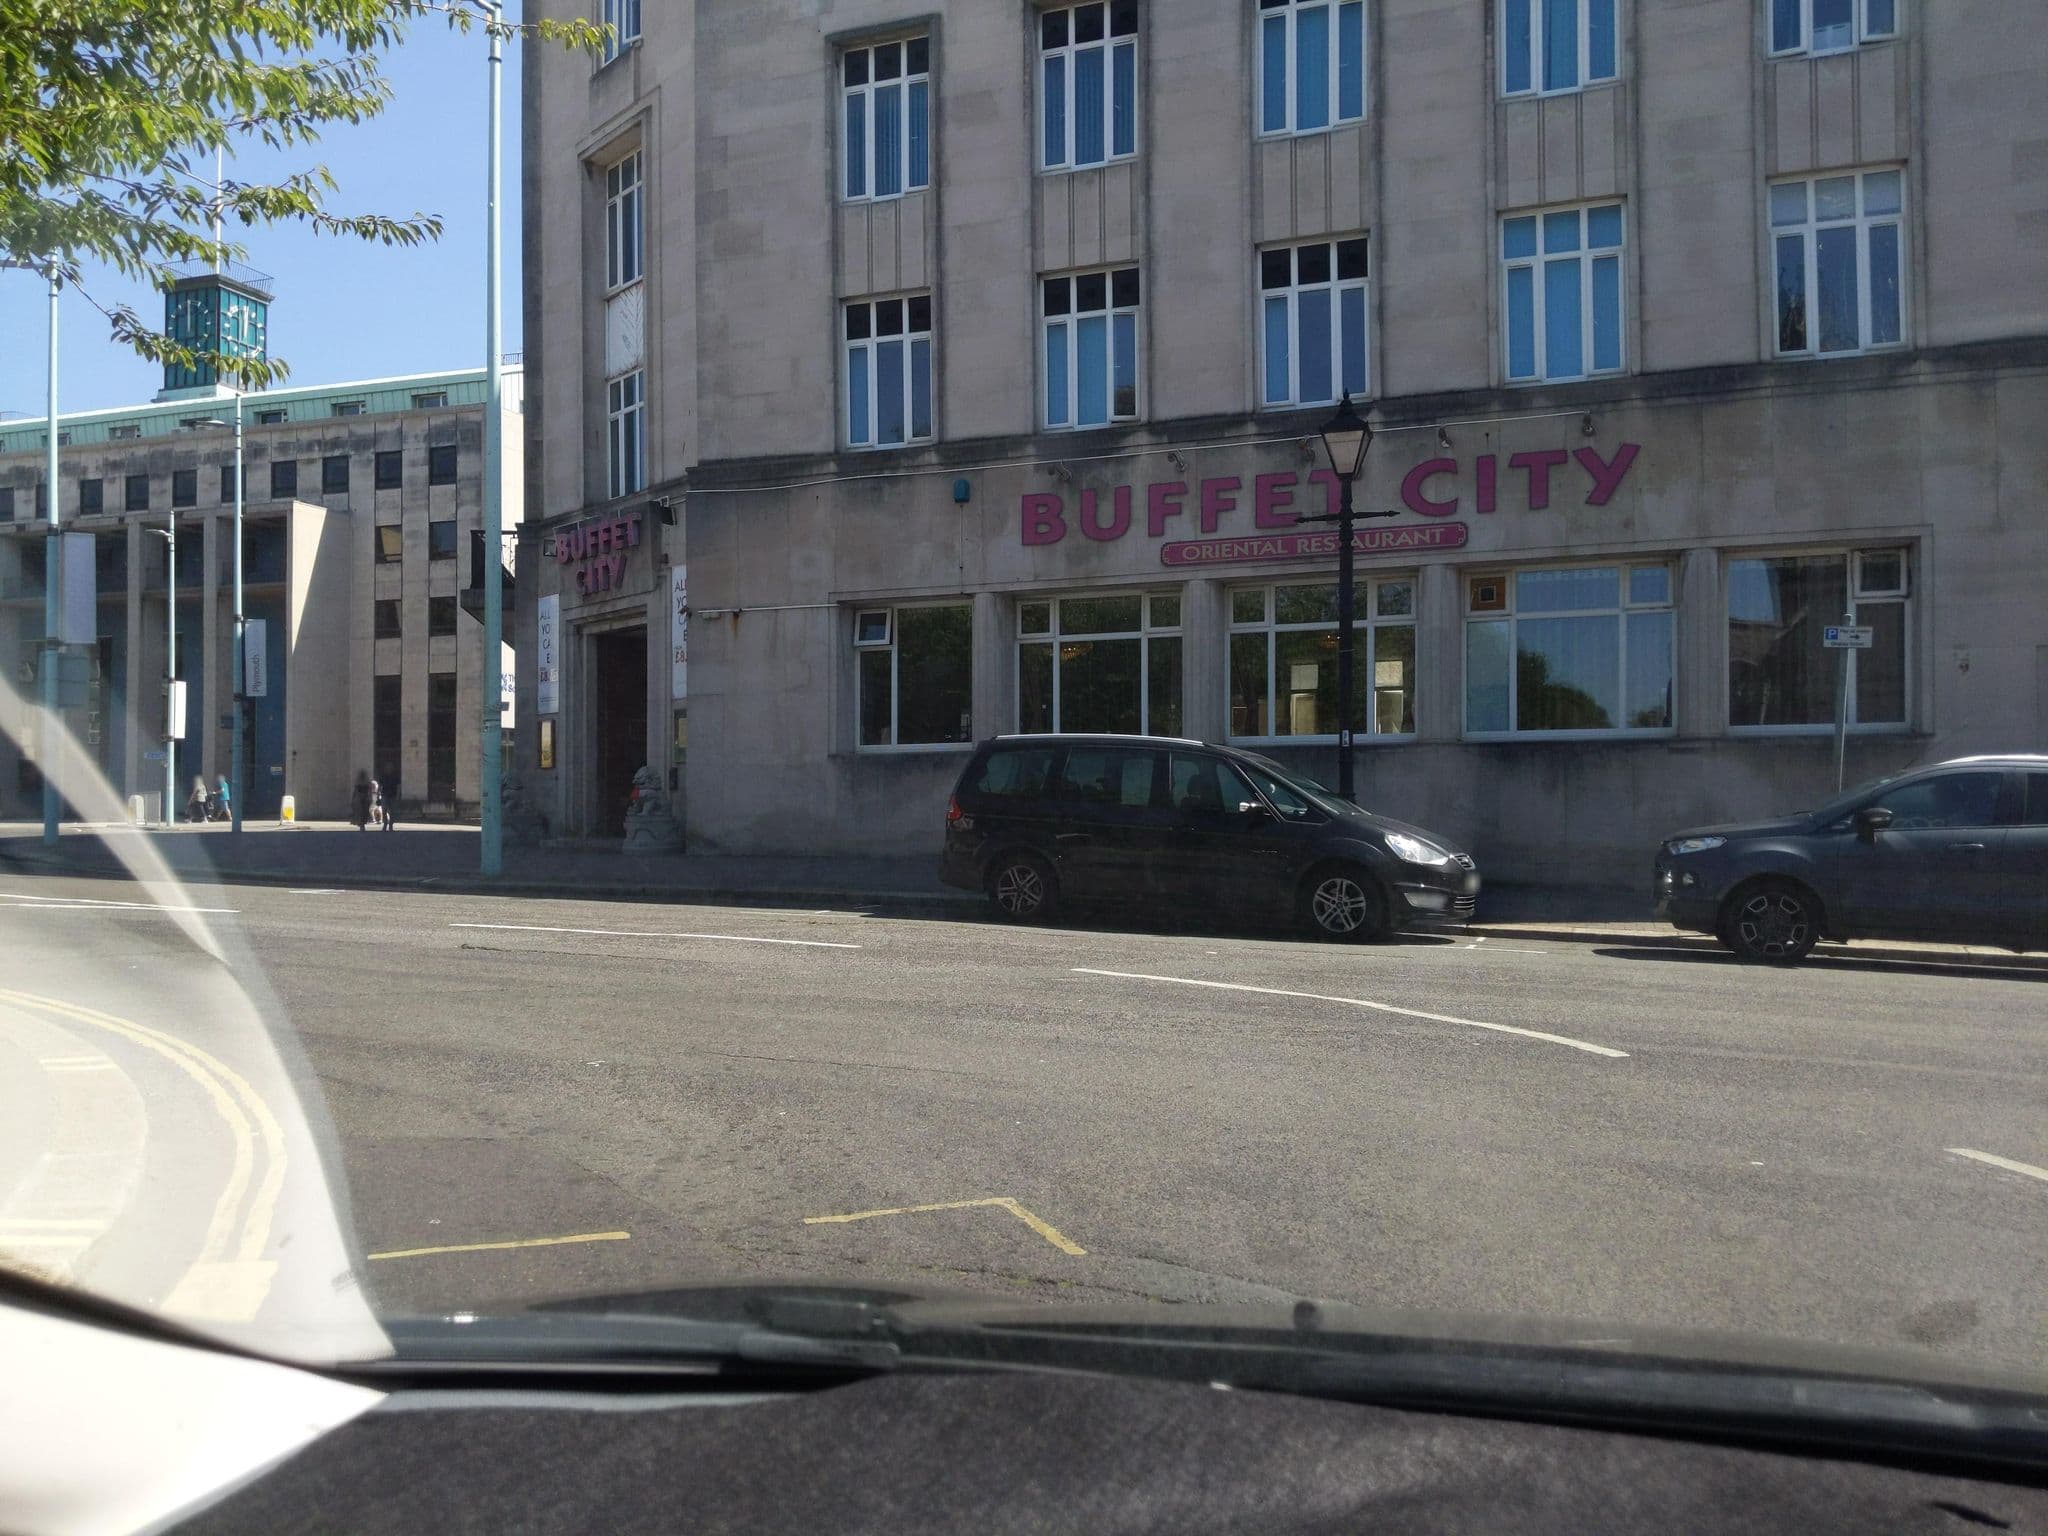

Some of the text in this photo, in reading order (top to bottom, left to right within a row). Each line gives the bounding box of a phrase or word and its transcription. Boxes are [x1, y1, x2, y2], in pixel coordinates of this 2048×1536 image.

[1021, 443, 1640, 546] BUFFET CITY
[556, 512, 641, 565] BUFFET
[1182, 540, 1288, 561] ORIENTAL
[576, 551, 626, 595] CITY
[249, 654, 262, 692] Plymouth
